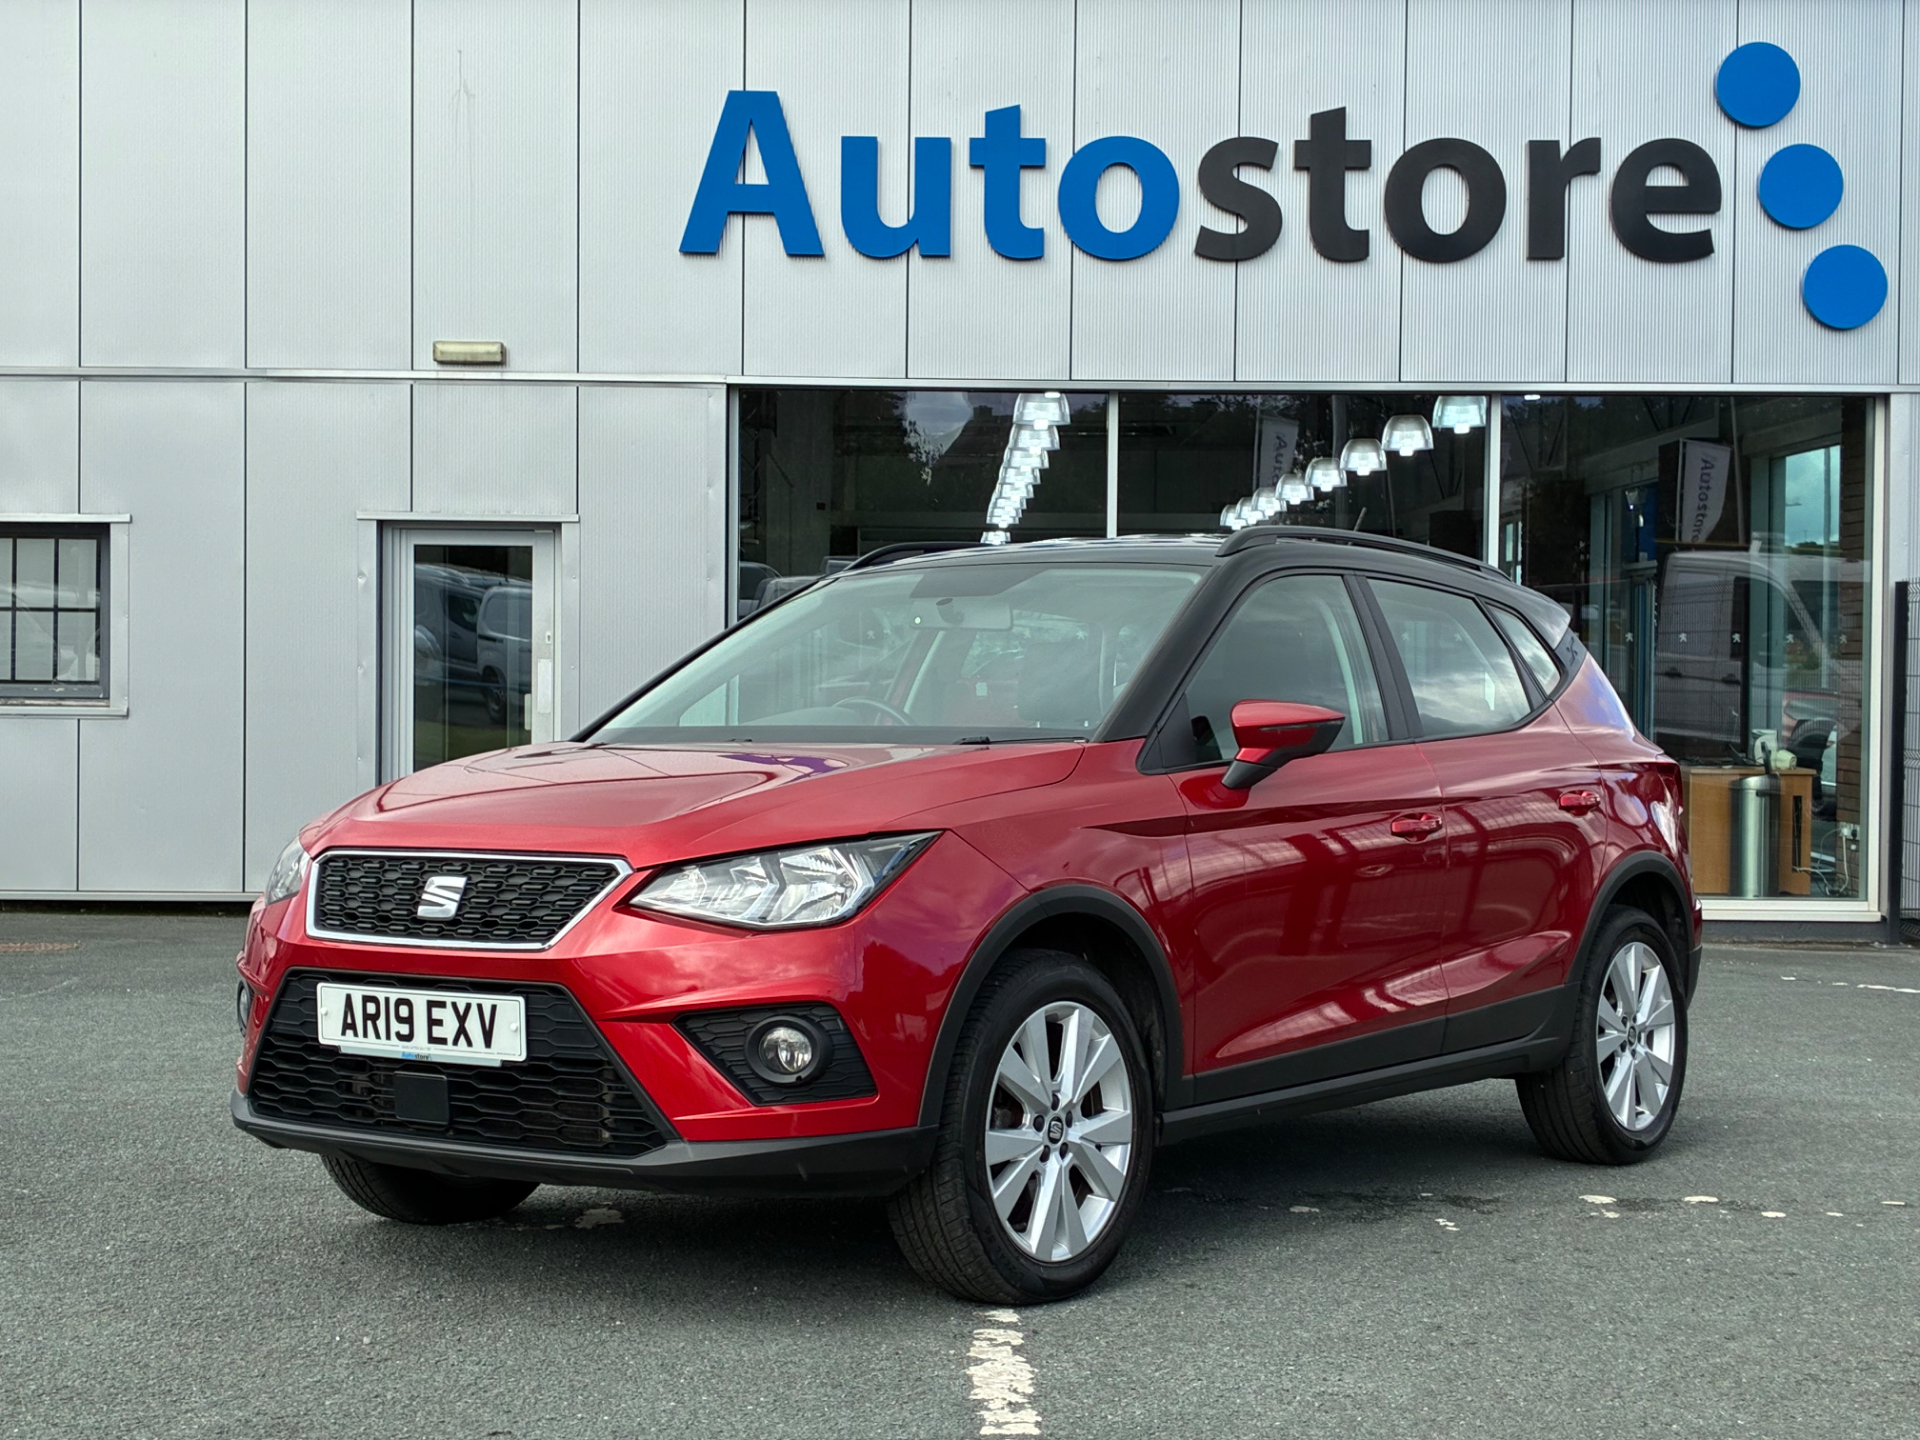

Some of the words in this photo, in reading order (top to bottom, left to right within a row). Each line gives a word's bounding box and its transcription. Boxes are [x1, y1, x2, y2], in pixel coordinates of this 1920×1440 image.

[679, 90, 1723, 263] Autostore
[341, 993, 415, 1043] AR19
[426, 999, 498, 1049] EXV
